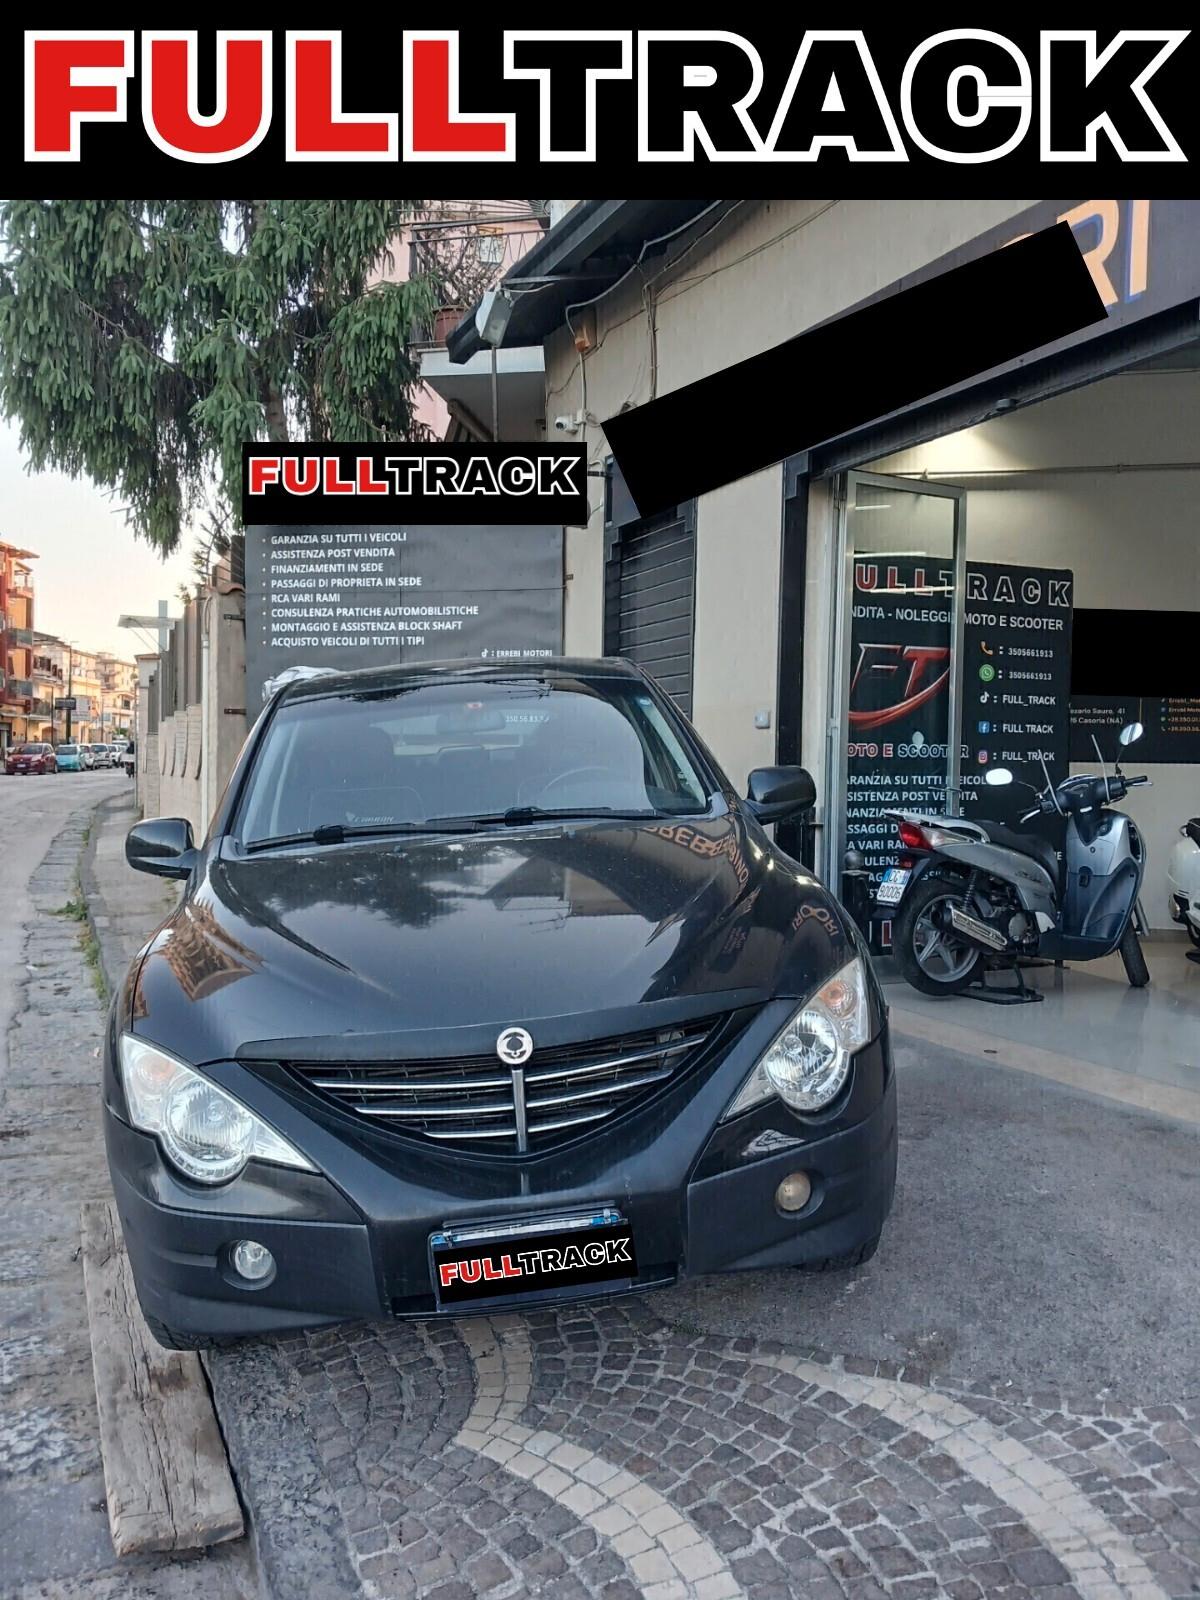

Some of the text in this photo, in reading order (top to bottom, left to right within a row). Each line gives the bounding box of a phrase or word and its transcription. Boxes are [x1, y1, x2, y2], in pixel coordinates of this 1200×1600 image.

[271, 532, 407, 544] GARANZIA SU TUTTI I VEICOLI
[270, 548, 395, 559] ASSISTENZA POST VENDITA
[271, 562, 384, 574] FINANZIAMENTI IN SEDE
[271, 576, 422, 588] PASSAGGI DI PROPRIETA IN SEDE
[271, 593, 340, 603] RCA VARI RAMI
[271, 606, 479, 618] CONSULENZA PRATICHE AUTOMOBILISTICHE
[852, 606, 885, 619] NDITA
[895, 608, 951, 622] NOLEGGI
[1000, 616, 1007, 626] E
[1010, 617, 1064, 630] SCOOTER
[271, 620, 463, 632] MONTAGGIO E ASSISTENZA BLOCK SHAFT
[271, 636, 424, 648] ACQUISTO VEICOLI DI TUTTI I TIPI
[1002, 694, 1056, 706] FULL_TRACK
[1003, 724, 1024, 733] FULL
[1025, 724, 1054, 734] TRACK
[848, 743, 969, 758] OTO E SCOOTR
[848, 776, 892, 785] RANZIA
[894, 776, 908, 785] SU
[912, 776, 942, 784] TUTTI
[847, 792, 899, 801] SISTENZA
[902, 791, 930, 801] POST
[847, 824, 887, 834] SSAGGI
[858, 840, 883, 850] VARI
